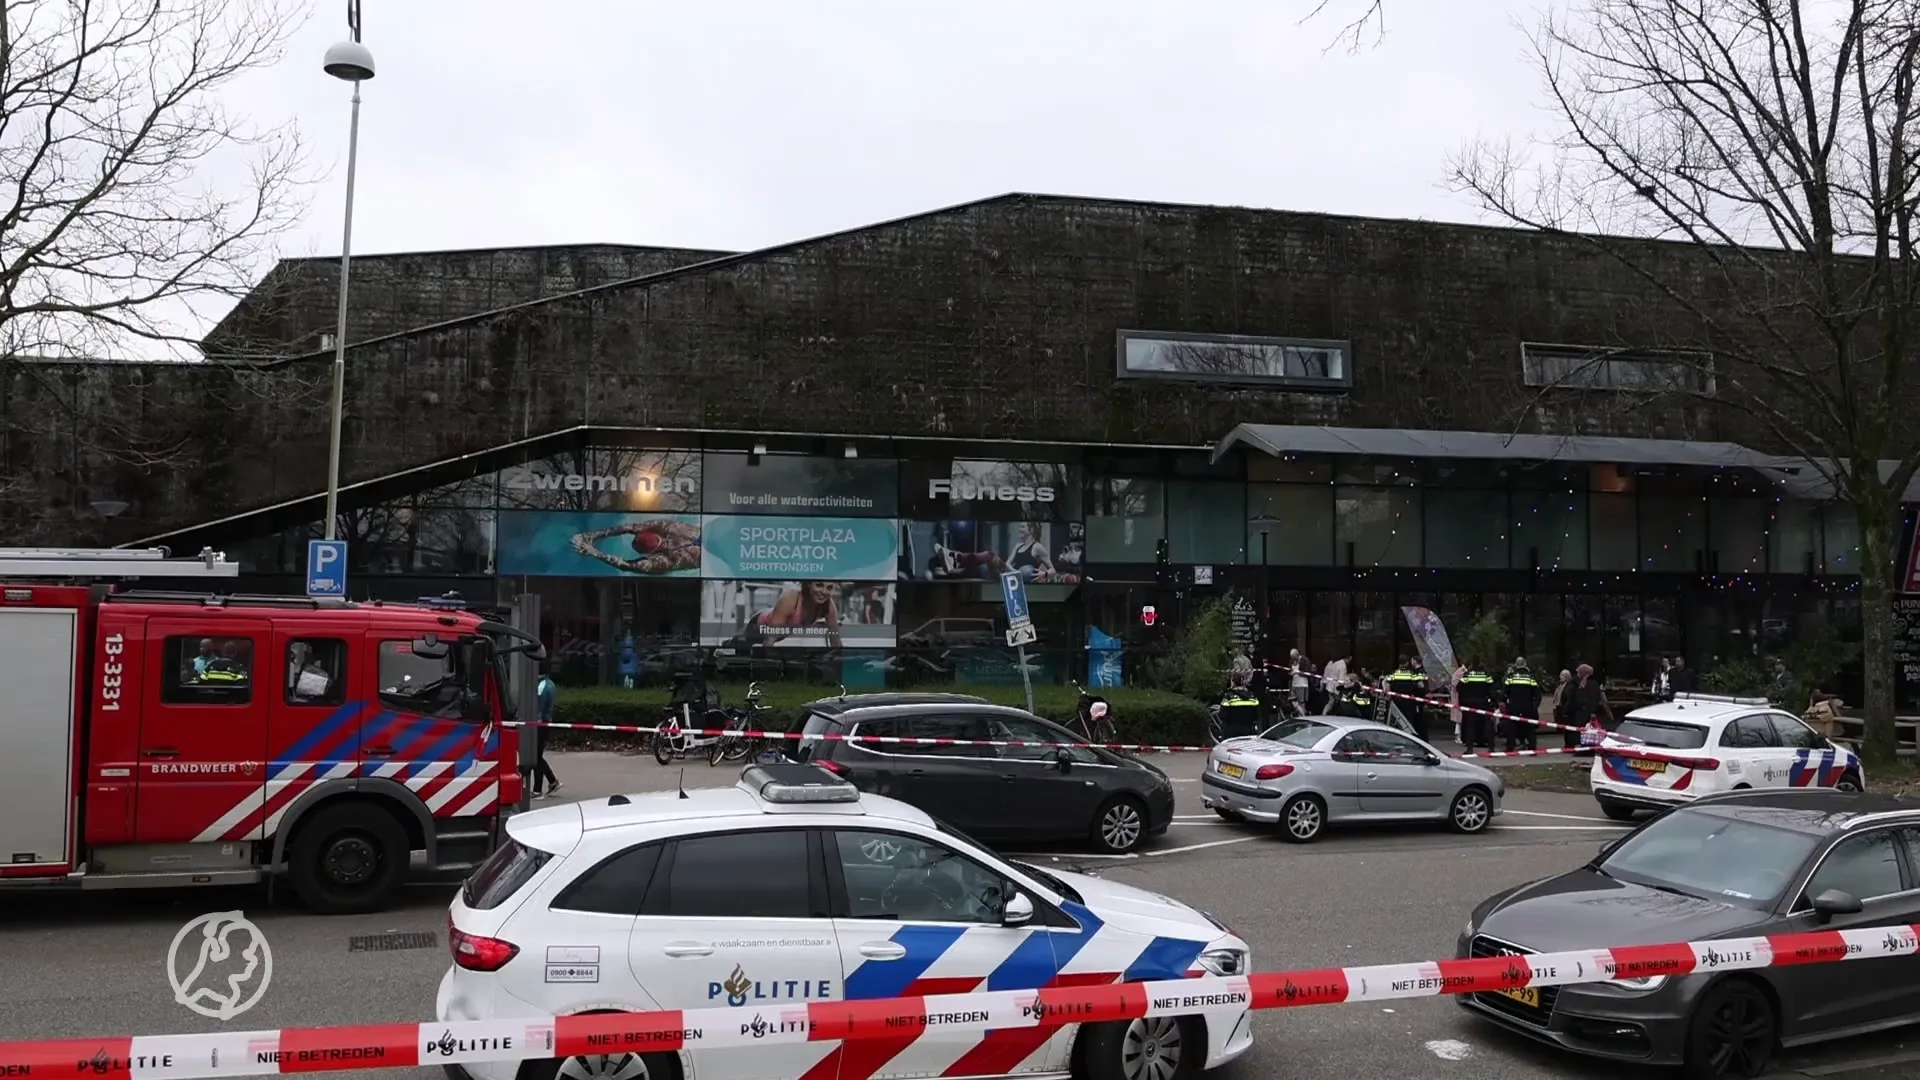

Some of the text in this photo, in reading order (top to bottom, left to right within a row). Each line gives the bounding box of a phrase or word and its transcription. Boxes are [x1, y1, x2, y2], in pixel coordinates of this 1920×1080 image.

[506, 471, 695, 493] Zwemmen
[928, 478, 1055, 502] Fitness
[729, 492, 873, 508] Voor alle wateractiviteiten
[739, 527, 856, 543] SPORTPLAZA
[316, 545, 338, 573] P
[739, 545, 838, 560] MERCATOR
[739, 562, 824, 572] SPORTFONDSEN
[1006, 575, 1019, 600] P
[759, 624, 839, 635] Fitness en meer...
[102, 633, 123, 711] 13-3331
[151, 763, 237, 774] BRANDWEER
[1763, 768, 1789, 782] POLITIE
[718, 938, 766, 948] waakzaam
[779, 938, 824, 948] dienstbaar
[1604, 959, 1679, 974] NIET BETREDEN
[1702, 951, 1752, 968] POLITIE
[1391, 976, 1475, 991] NIET BETREDEN
[1502, 966, 1556, 983] POLITIE
[708, 979, 831, 1007] POLITIE
[1153, 992, 1246, 1009] NIET BETREDEN
[1276, 983, 1339, 1001] POLITIE
[885, 1010, 989, 1028] NIET BETREDEN
[1022, 1002, 1093, 1020] POLITIE
[587, 1028, 703, 1046] NIET BETREDEN
[741, 1020, 817, 1038] POLITIE
[257, 1046, 385, 1064] NIET BETREDEN
[426, 1037, 512, 1056] POLITIE
[77, 1055, 173, 1075] POLITIE
